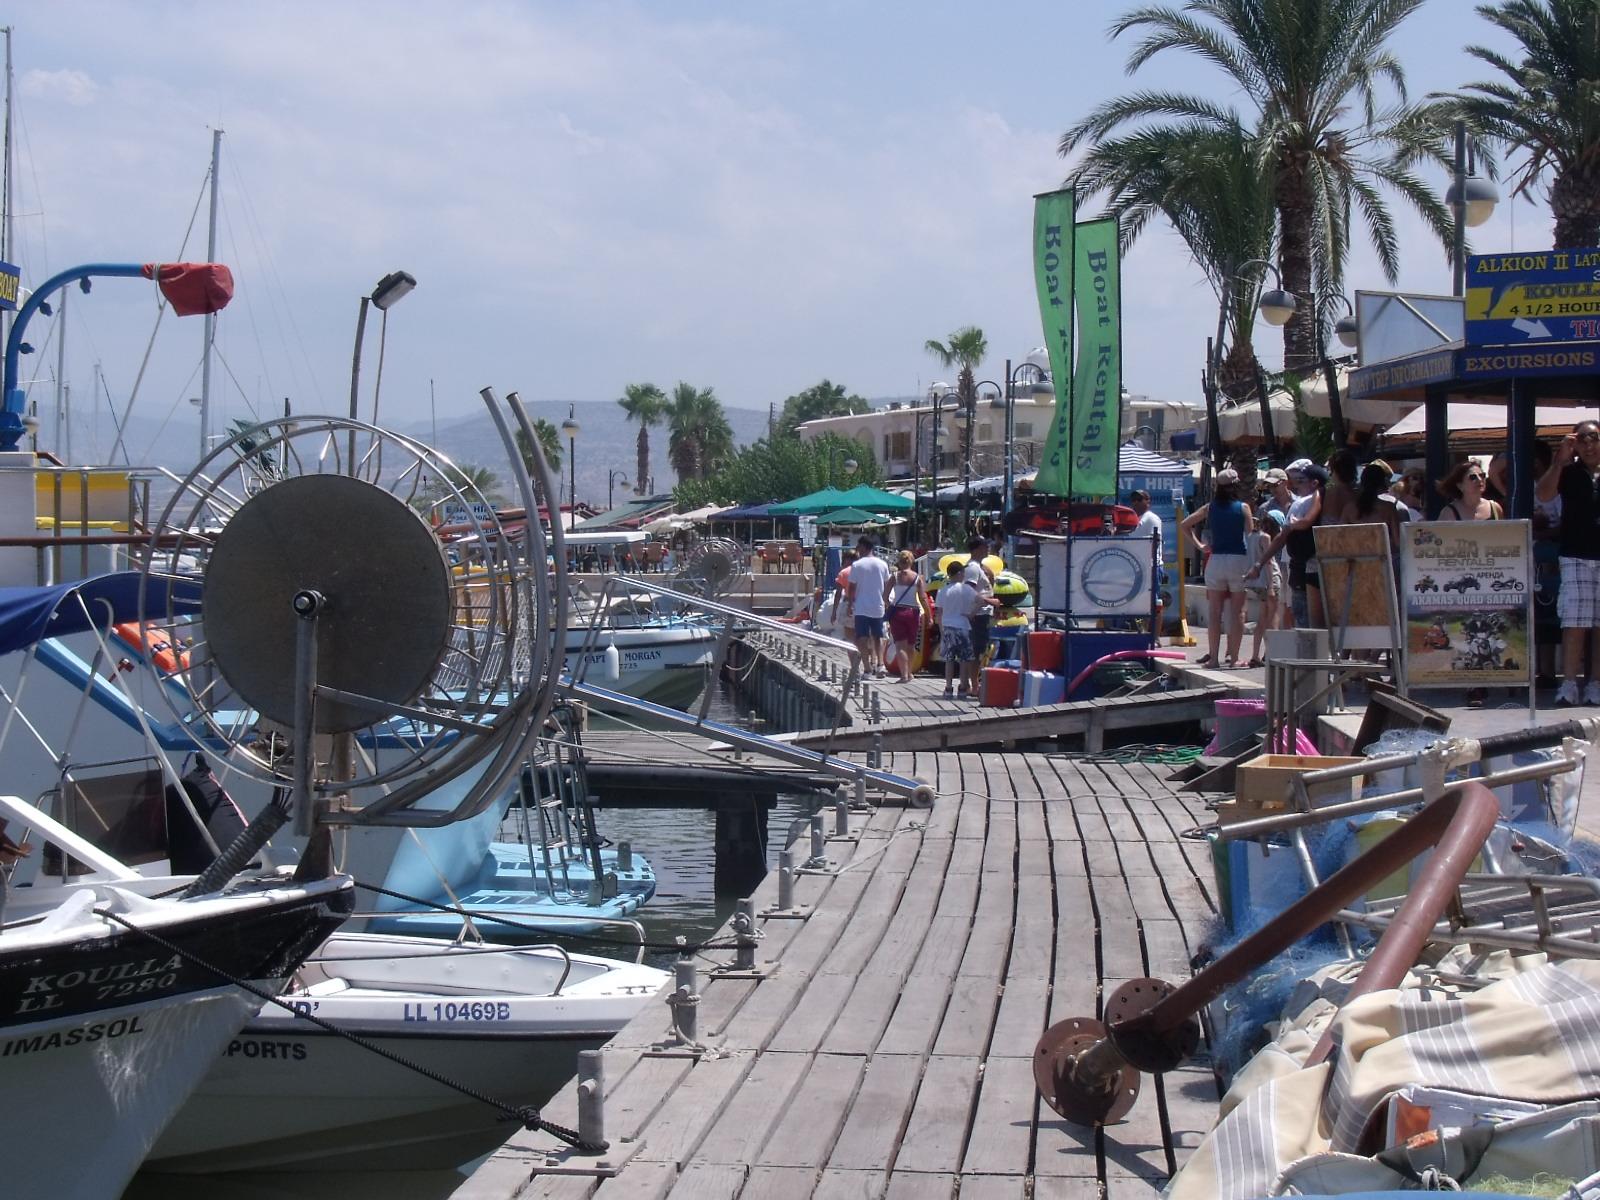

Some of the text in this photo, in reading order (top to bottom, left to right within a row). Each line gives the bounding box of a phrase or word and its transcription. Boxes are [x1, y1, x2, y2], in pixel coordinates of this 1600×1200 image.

[1476, 253, 1600, 272] ALKION II LAT
[1087, 247, 1110, 327] Boat
[1510, 305, 1519, 315] 4
[1527, 304, 1553, 315] 1/2
[1570, 319, 1600, 338] TI
[1391, 356, 1453, 385] INFORMATION
[1465, 352, 1595, 371] EXCURSIONS
[1077, 343, 1111, 470] Rentals
[1145, 477, 1184, 489] HIRE
[1438, 558, 1495, 567] RENTALS
[1411, 594, 1523, 605] AKAMAS QUAD SAFARI
[624, 650, 661, 661] MORGAN
[23, 953, 183, 994] KOULLA
[15, 973, 177, 1014] LL 7280
[404, 1002, 510, 1022] LL 10469B
[2, 1016, 144, 1056] IMASSOL
[223, 1040, 307, 1060] PORTS
